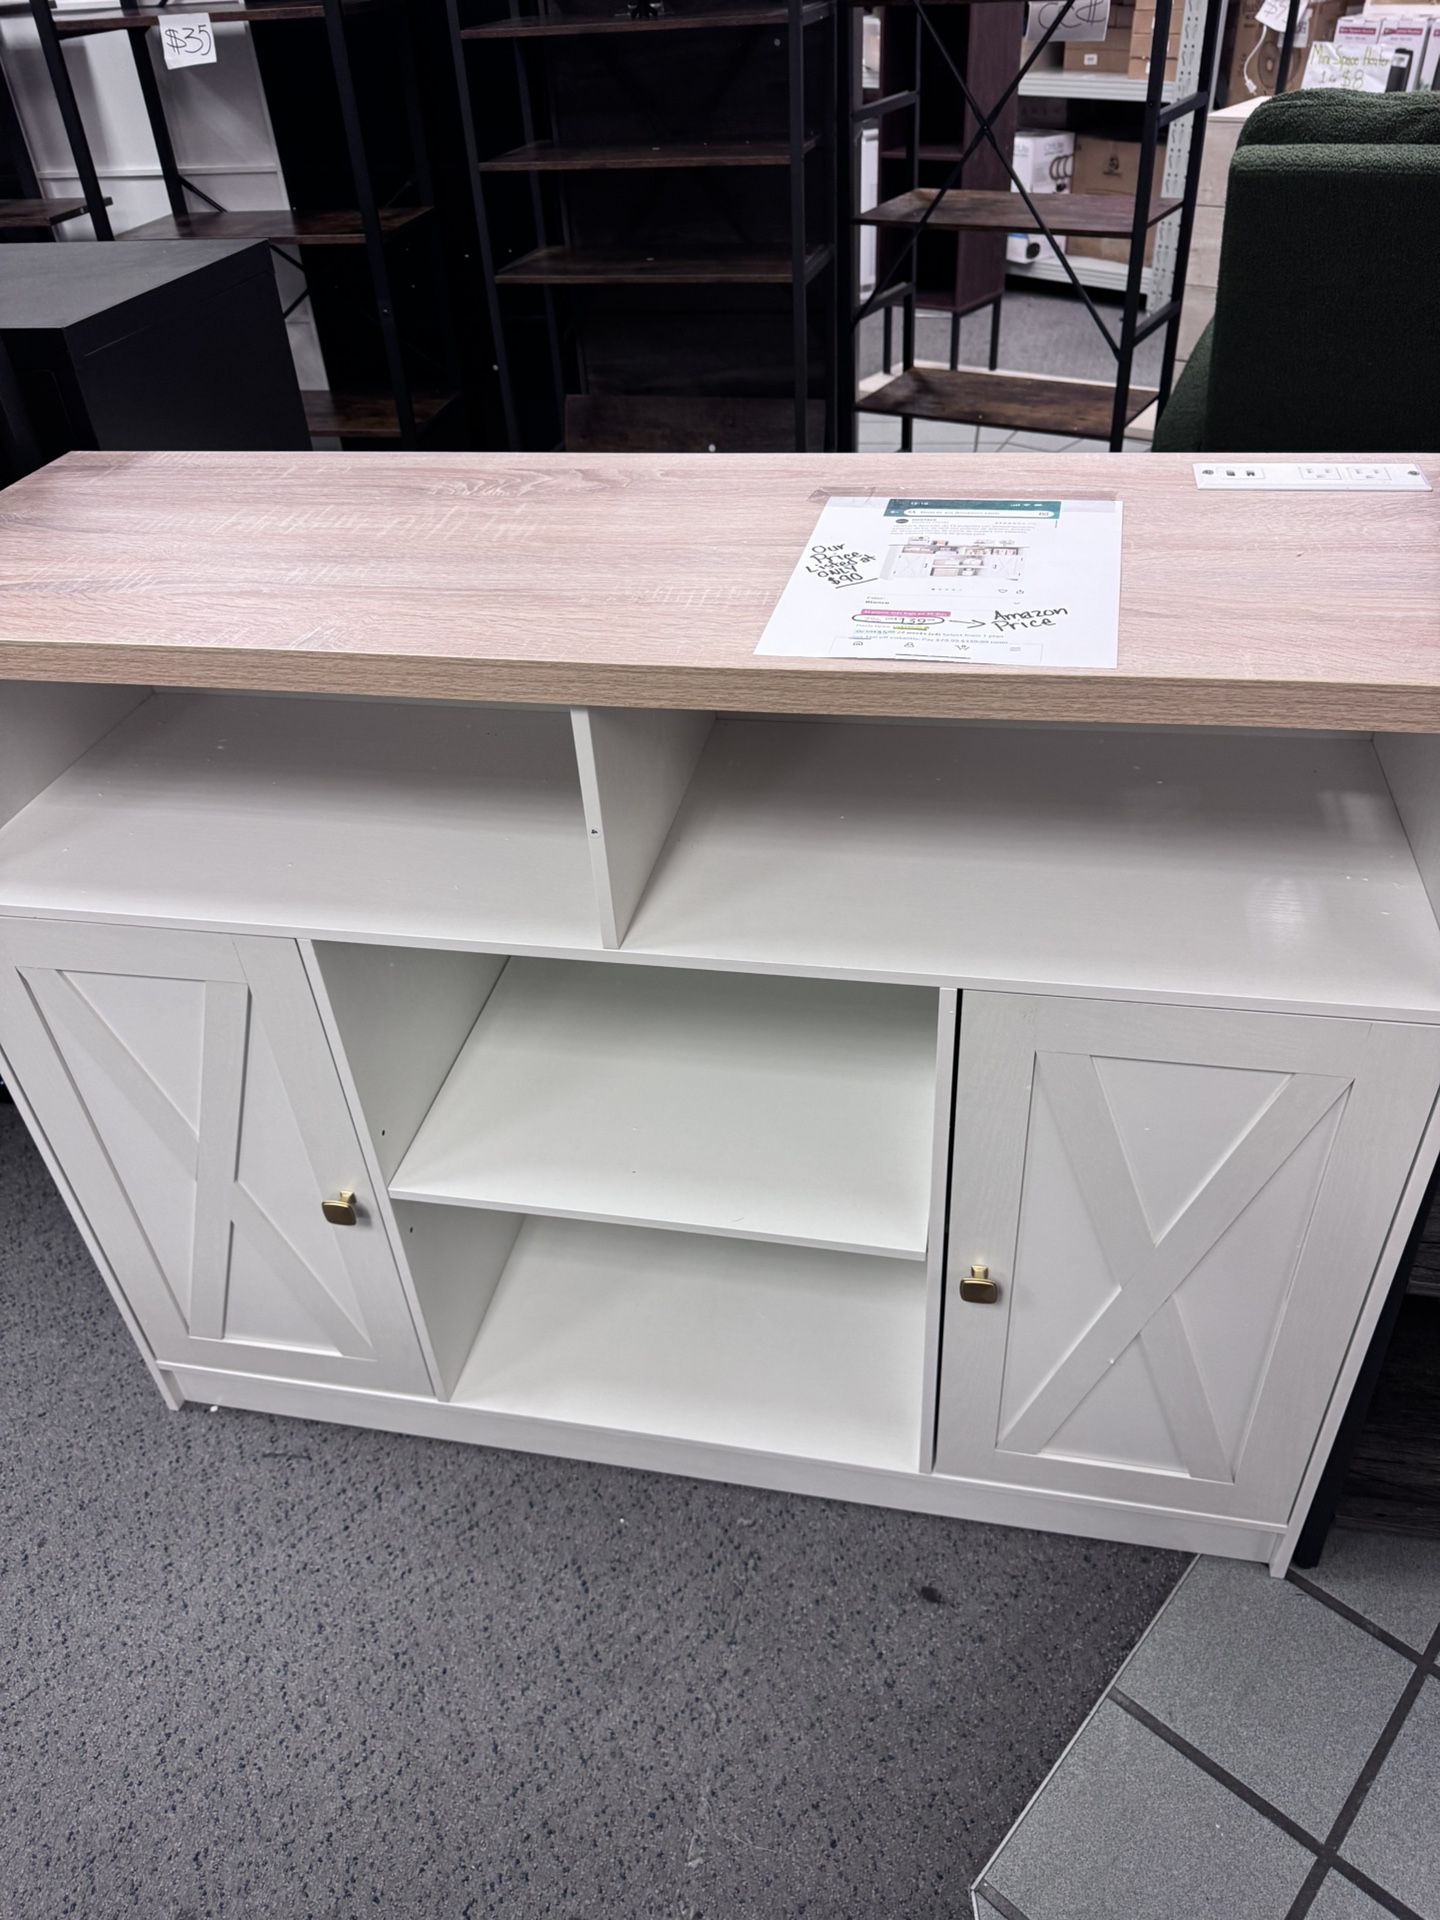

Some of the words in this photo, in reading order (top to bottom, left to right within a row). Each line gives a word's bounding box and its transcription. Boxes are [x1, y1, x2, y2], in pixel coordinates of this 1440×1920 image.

[164, 24, 212, 56] $35
[1309, 43, 1330, 65] Mini
[1333, 43, 1360, 71] Space
[1362, 45, 1391, 67] Heater
[811, 543, 846, 554] Our
[809, 551, 863, 564] Price
[860, 553, 877, 563] at
[827, 572, 864, 585] $90
[993, 607, 1069, 621] Amazon
[991, 618, 1058, 632] Price
